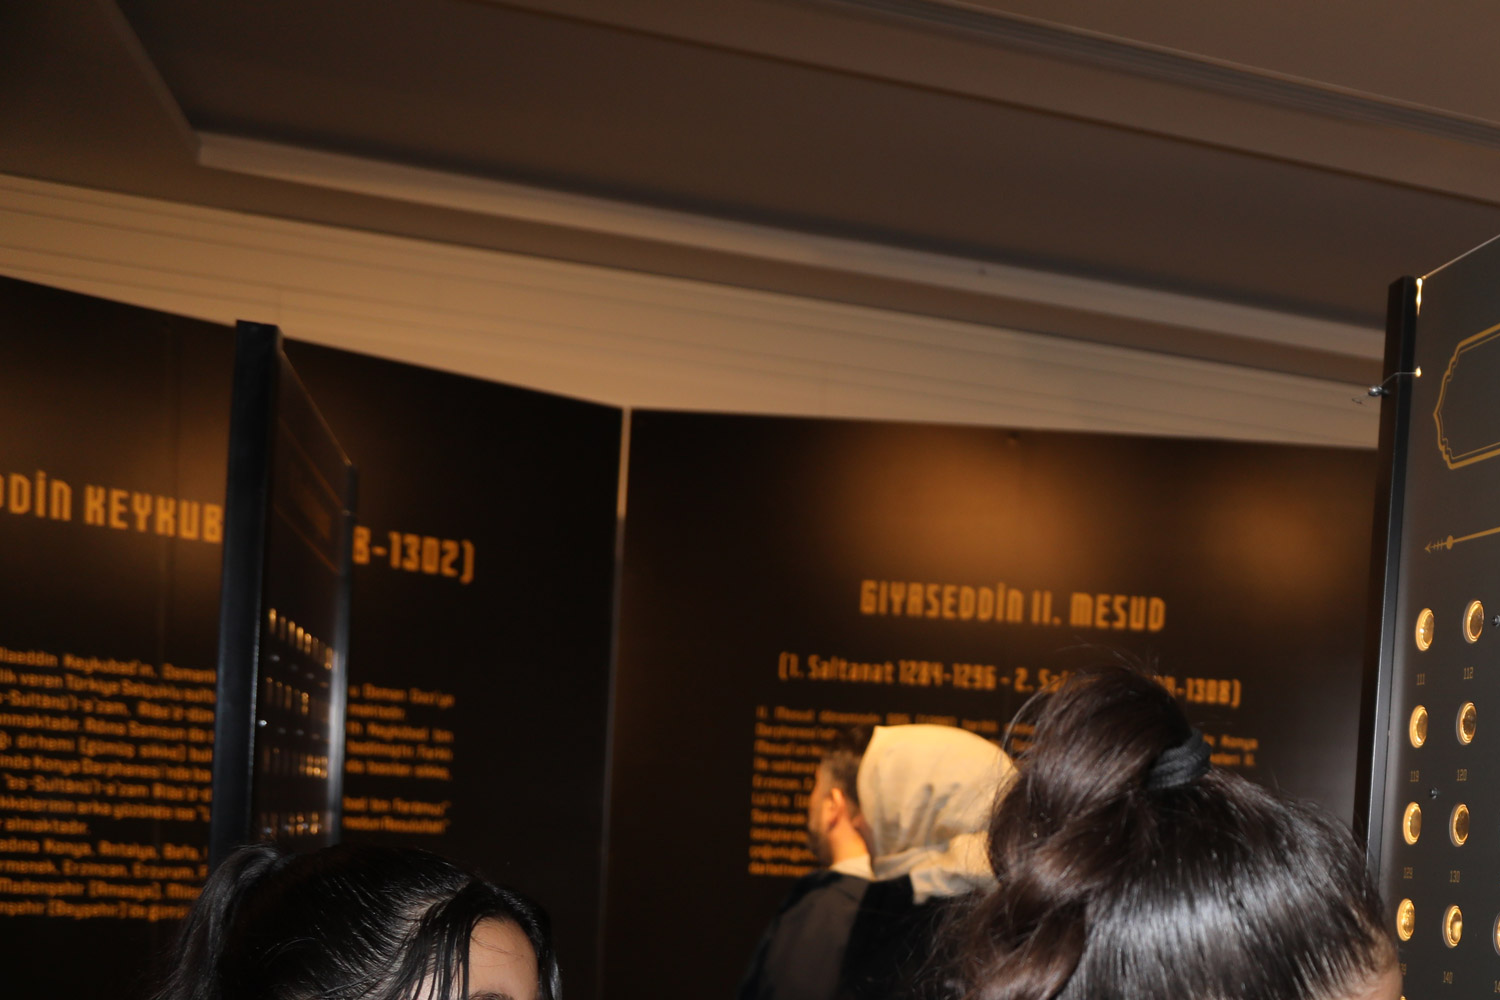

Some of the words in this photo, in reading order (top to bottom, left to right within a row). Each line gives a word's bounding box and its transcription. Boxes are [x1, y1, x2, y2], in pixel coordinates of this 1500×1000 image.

[0, 470, 72, 522] DİN
[1070, 591, 1166, 632] MESUD
[808, 654, 894, 683] Saltanat
[1462, 665, 1475, 681] 112
